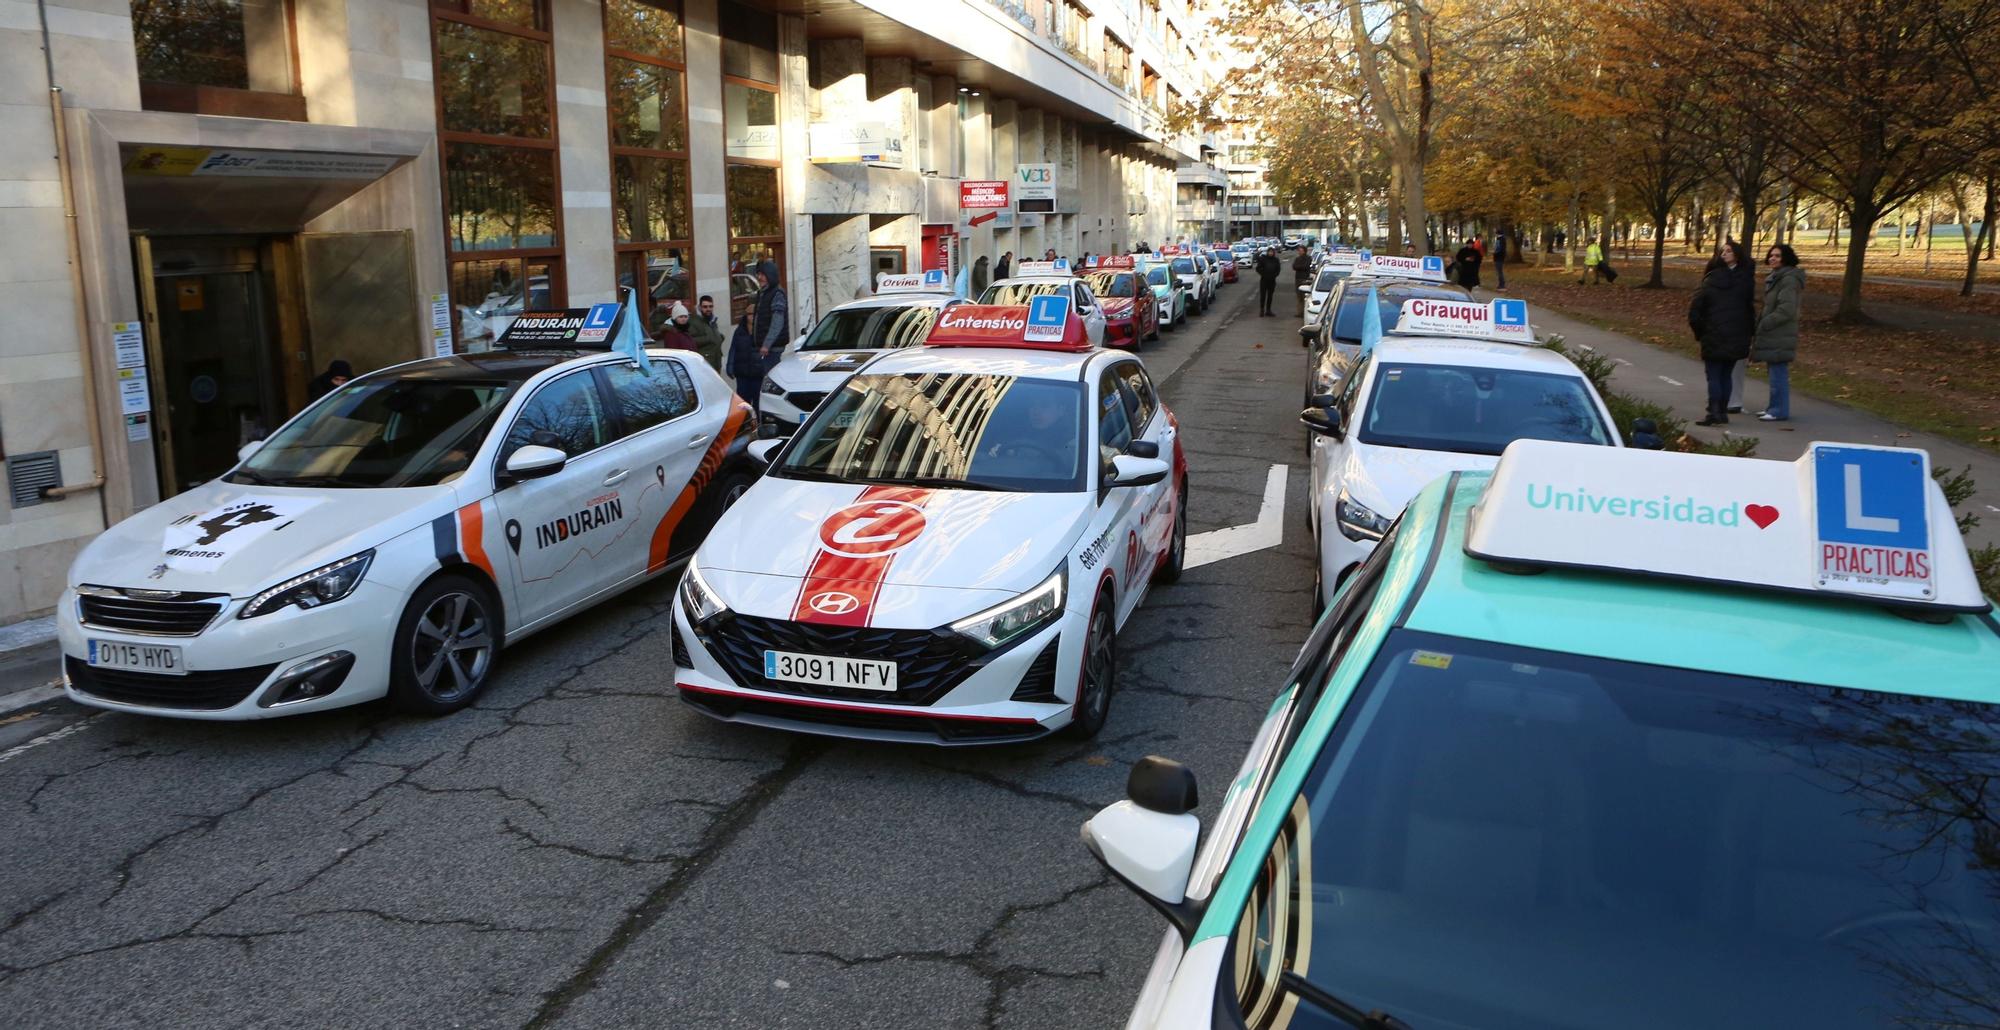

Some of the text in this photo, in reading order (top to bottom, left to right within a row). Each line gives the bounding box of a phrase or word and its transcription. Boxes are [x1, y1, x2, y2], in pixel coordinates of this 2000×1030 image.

[223, 158, 256, 167] DGT
[963, 194, 1006, 202] CONDUCTORES
[1376, 256, 1420, 270] Cirauqui
[1427, 259, 1437, 270] L
[883, 278, 919, 287] Orvina
[928, 272, 938, 282] L
[591, 307, 606, 326] L
[940, 308, 1024, 330] intensivo
[1038, 300, 1056, 322] L
[1412, 300, 1488, 324] Cirauqui
[1501, 304, 1518, 322] L
[514, 318, 585, 329] INDURAIN
[1028, 326, 1062, 336] PRACTICAS
[1495, 324, 1525, 333] PRACTICAS
[580, 328, 608, 337] PRACTICAS
[1526, 483, 1740, 528] Universidad
[1844, 463, 1900, 533] L
[223, 502, 257, 512] SIN
[536, 498, 623, 550] INDURAIN
[1824, 544, 1930, 580] PRACTICAS
[101, 644, 174, 669] 0115 HYD
[780, 656, 834, 682] 3091
[846, 662, 890, 686] NFV
